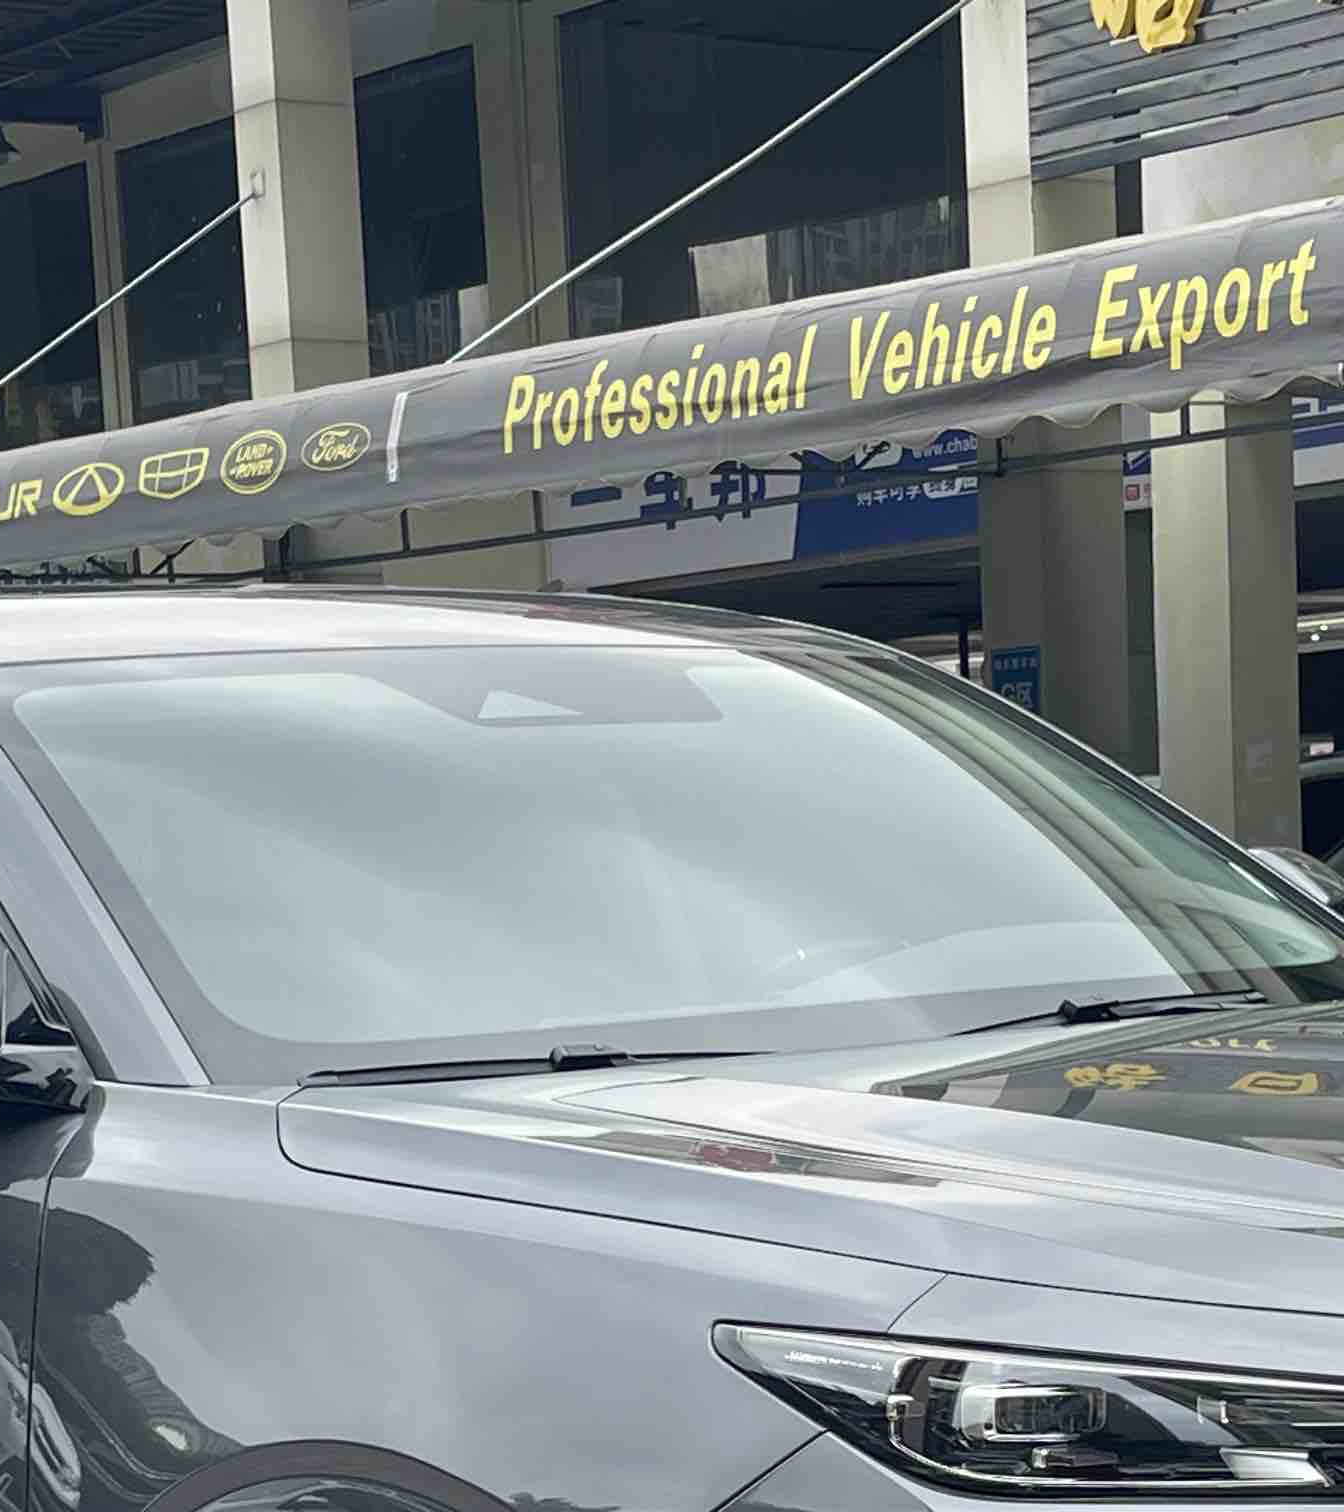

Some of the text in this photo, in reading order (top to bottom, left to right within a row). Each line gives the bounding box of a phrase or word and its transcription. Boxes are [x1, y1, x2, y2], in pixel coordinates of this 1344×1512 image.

[503, 238, 1317, 455] Professional Vehicle Export
